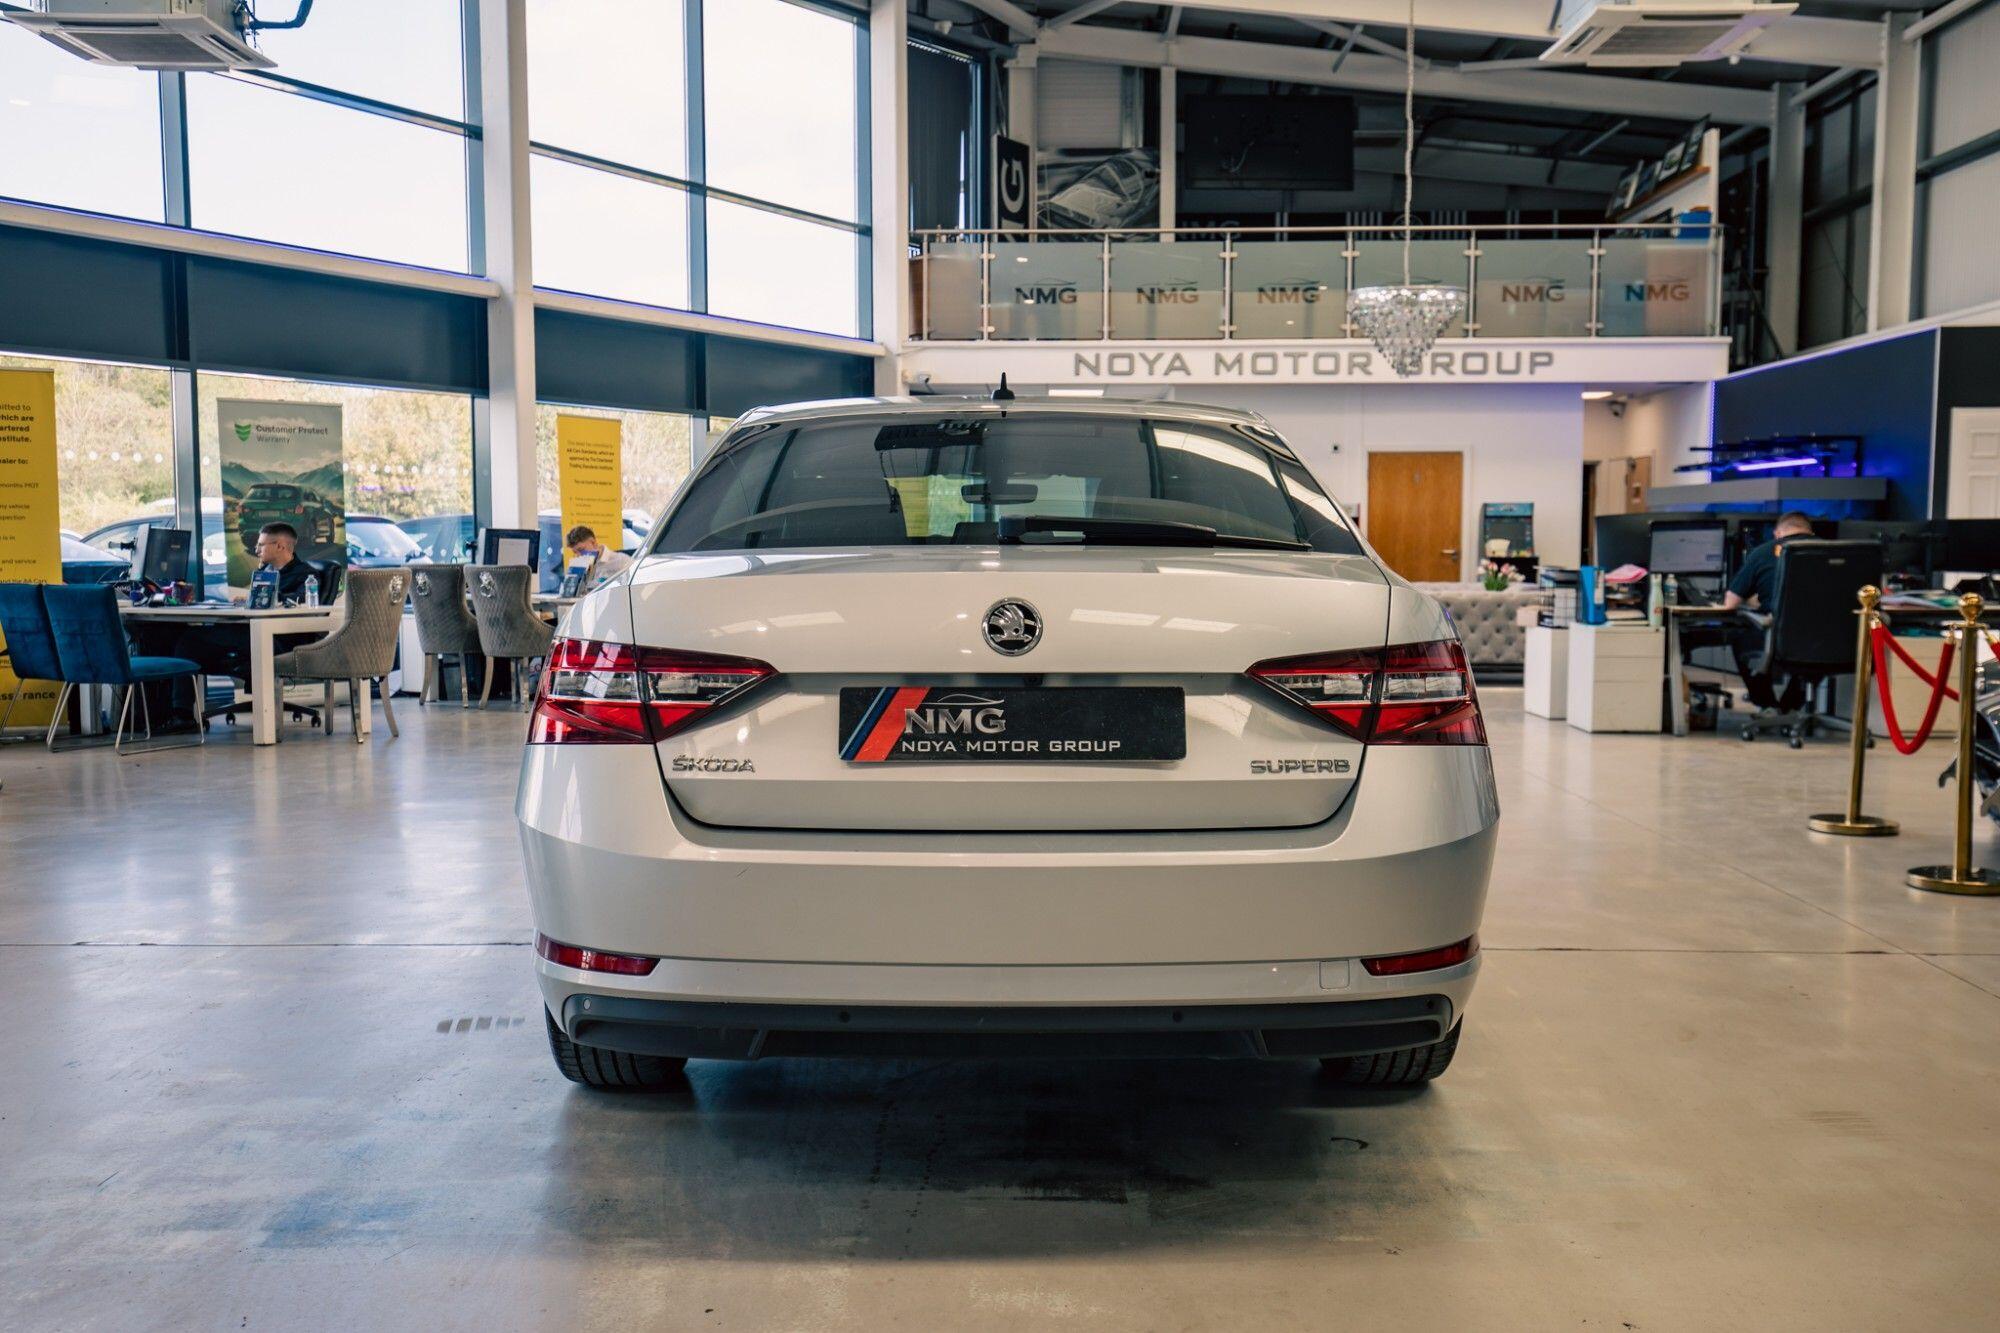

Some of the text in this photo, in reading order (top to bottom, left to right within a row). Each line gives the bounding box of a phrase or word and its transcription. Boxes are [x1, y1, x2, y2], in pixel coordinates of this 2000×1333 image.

[1015, 287, 1077, 304] NMG
[1136, 287, 1199, 304] NMG
[1257, 287, 1321, 304] NMG
[1502, 285, 1565, 302] NMG
[1625, 284, 1689, 301] NMG
[1074, 352, 1191, 376] NOYA
[1214, 352, 1371, 376] MOTOR
[22, 404, 31, 412] to
[255, 424, 329, 435] Customer Protect
[904, 708, 1006, 735] NMG
[902, 740, 1121, 752] NOYA MOTOR GROUP
[672, 754, 756, 773] ŠKODA
[1250, 759, 1351, 774] SUPERB
